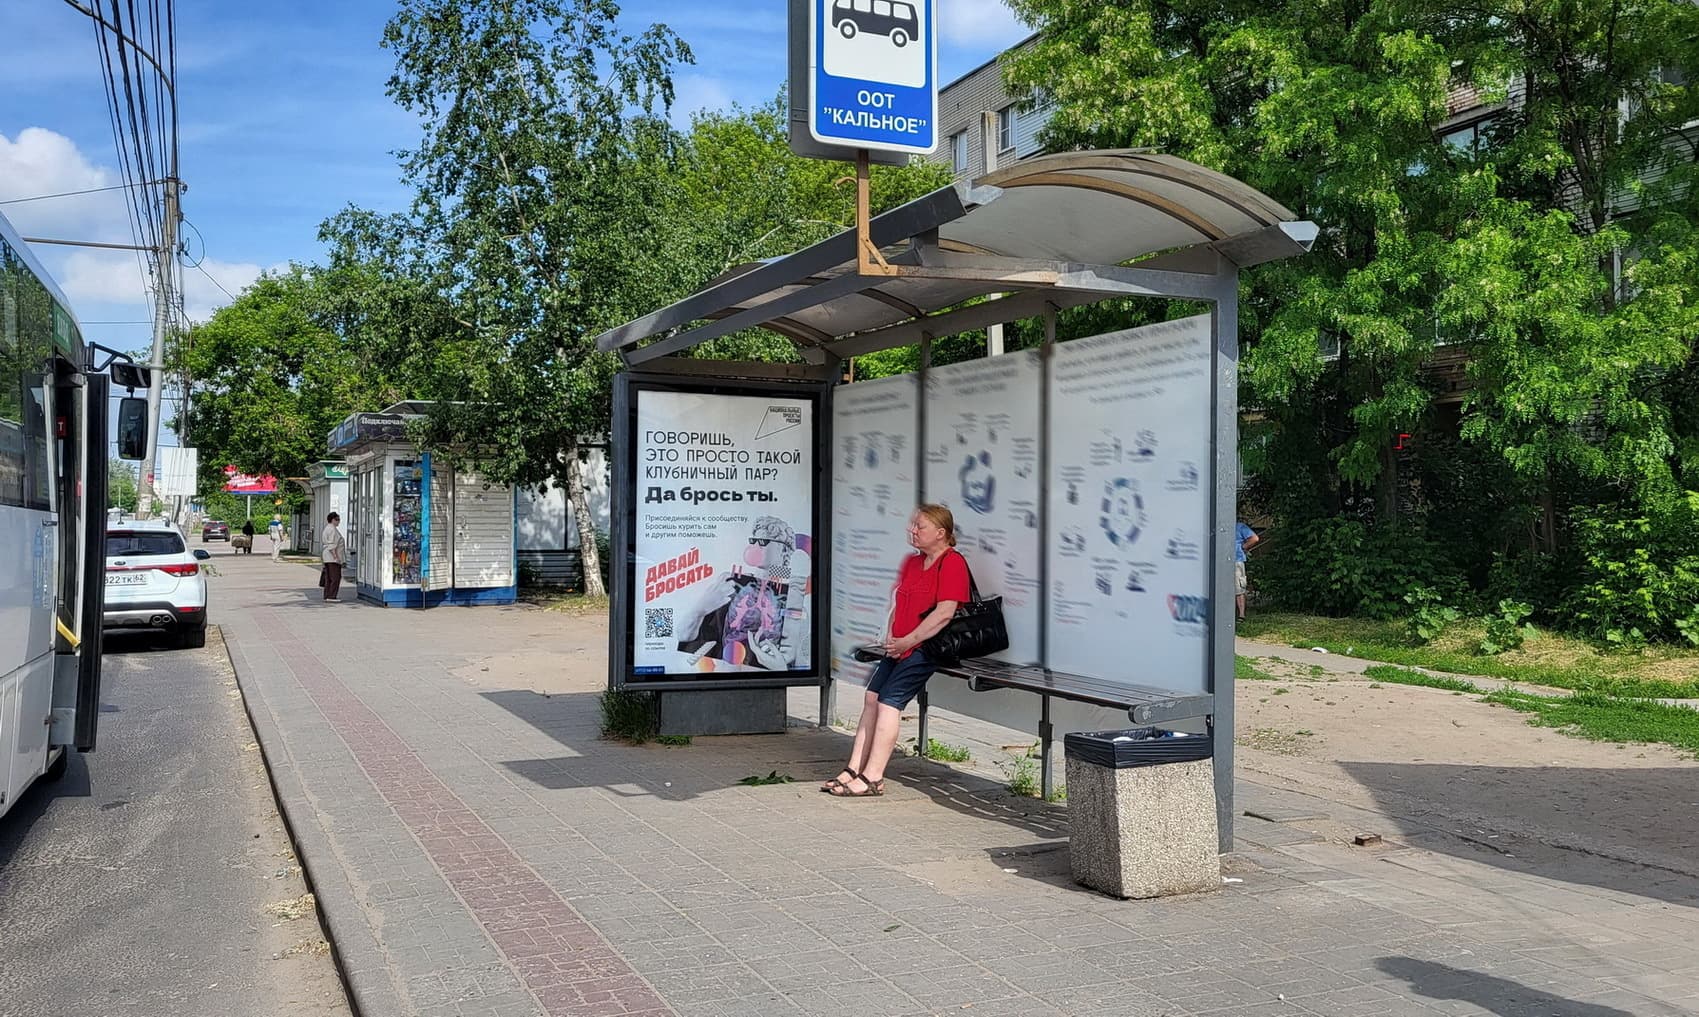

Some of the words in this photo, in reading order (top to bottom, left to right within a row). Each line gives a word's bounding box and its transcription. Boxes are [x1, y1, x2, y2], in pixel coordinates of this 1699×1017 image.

[857, 90, 896, 109] ООТ
[645, 430, 735, 447] ГОВОРИШЬ,
[645, 448, 679, 462] ЭТО
[686, 449, 750, 464] ПРОСТО
[757, 449, 801, 464] ТАКОЙ
[745, 467, 778, 481] ПАР?
[644, 486, 676, 504] Да
[680, 486, 743, 505] брось
[746, 490, 778, 502] ты.
[645, 514, 700, 522] Присоединяйся
[645, 546, 699, 586] ДАВАЙ
[645, 563, 714, 602] БРОСАТЬ
